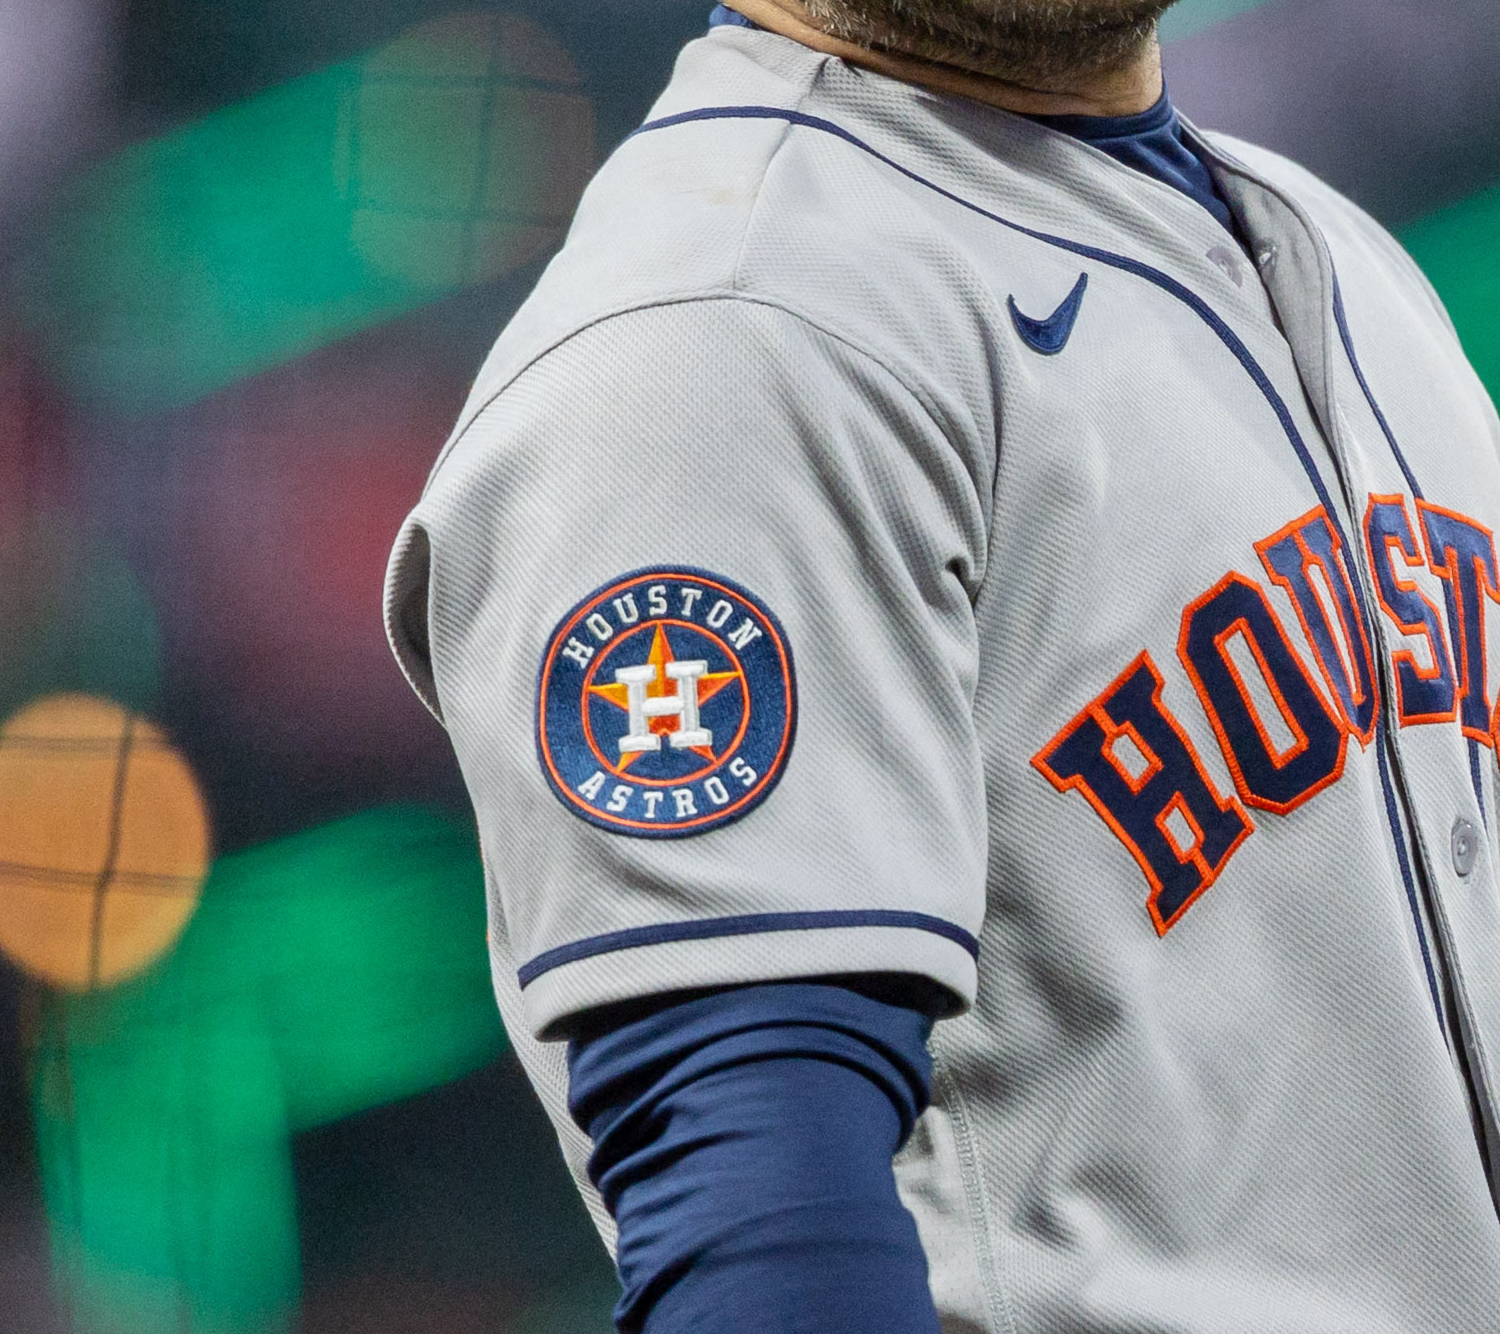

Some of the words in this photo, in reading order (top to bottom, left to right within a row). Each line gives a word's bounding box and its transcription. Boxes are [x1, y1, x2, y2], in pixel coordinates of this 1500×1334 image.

[563, 585, 762, 668] HOUSTON
[615, 660, 712, 752] H
[578, 757, 757, 818] ASTROS
